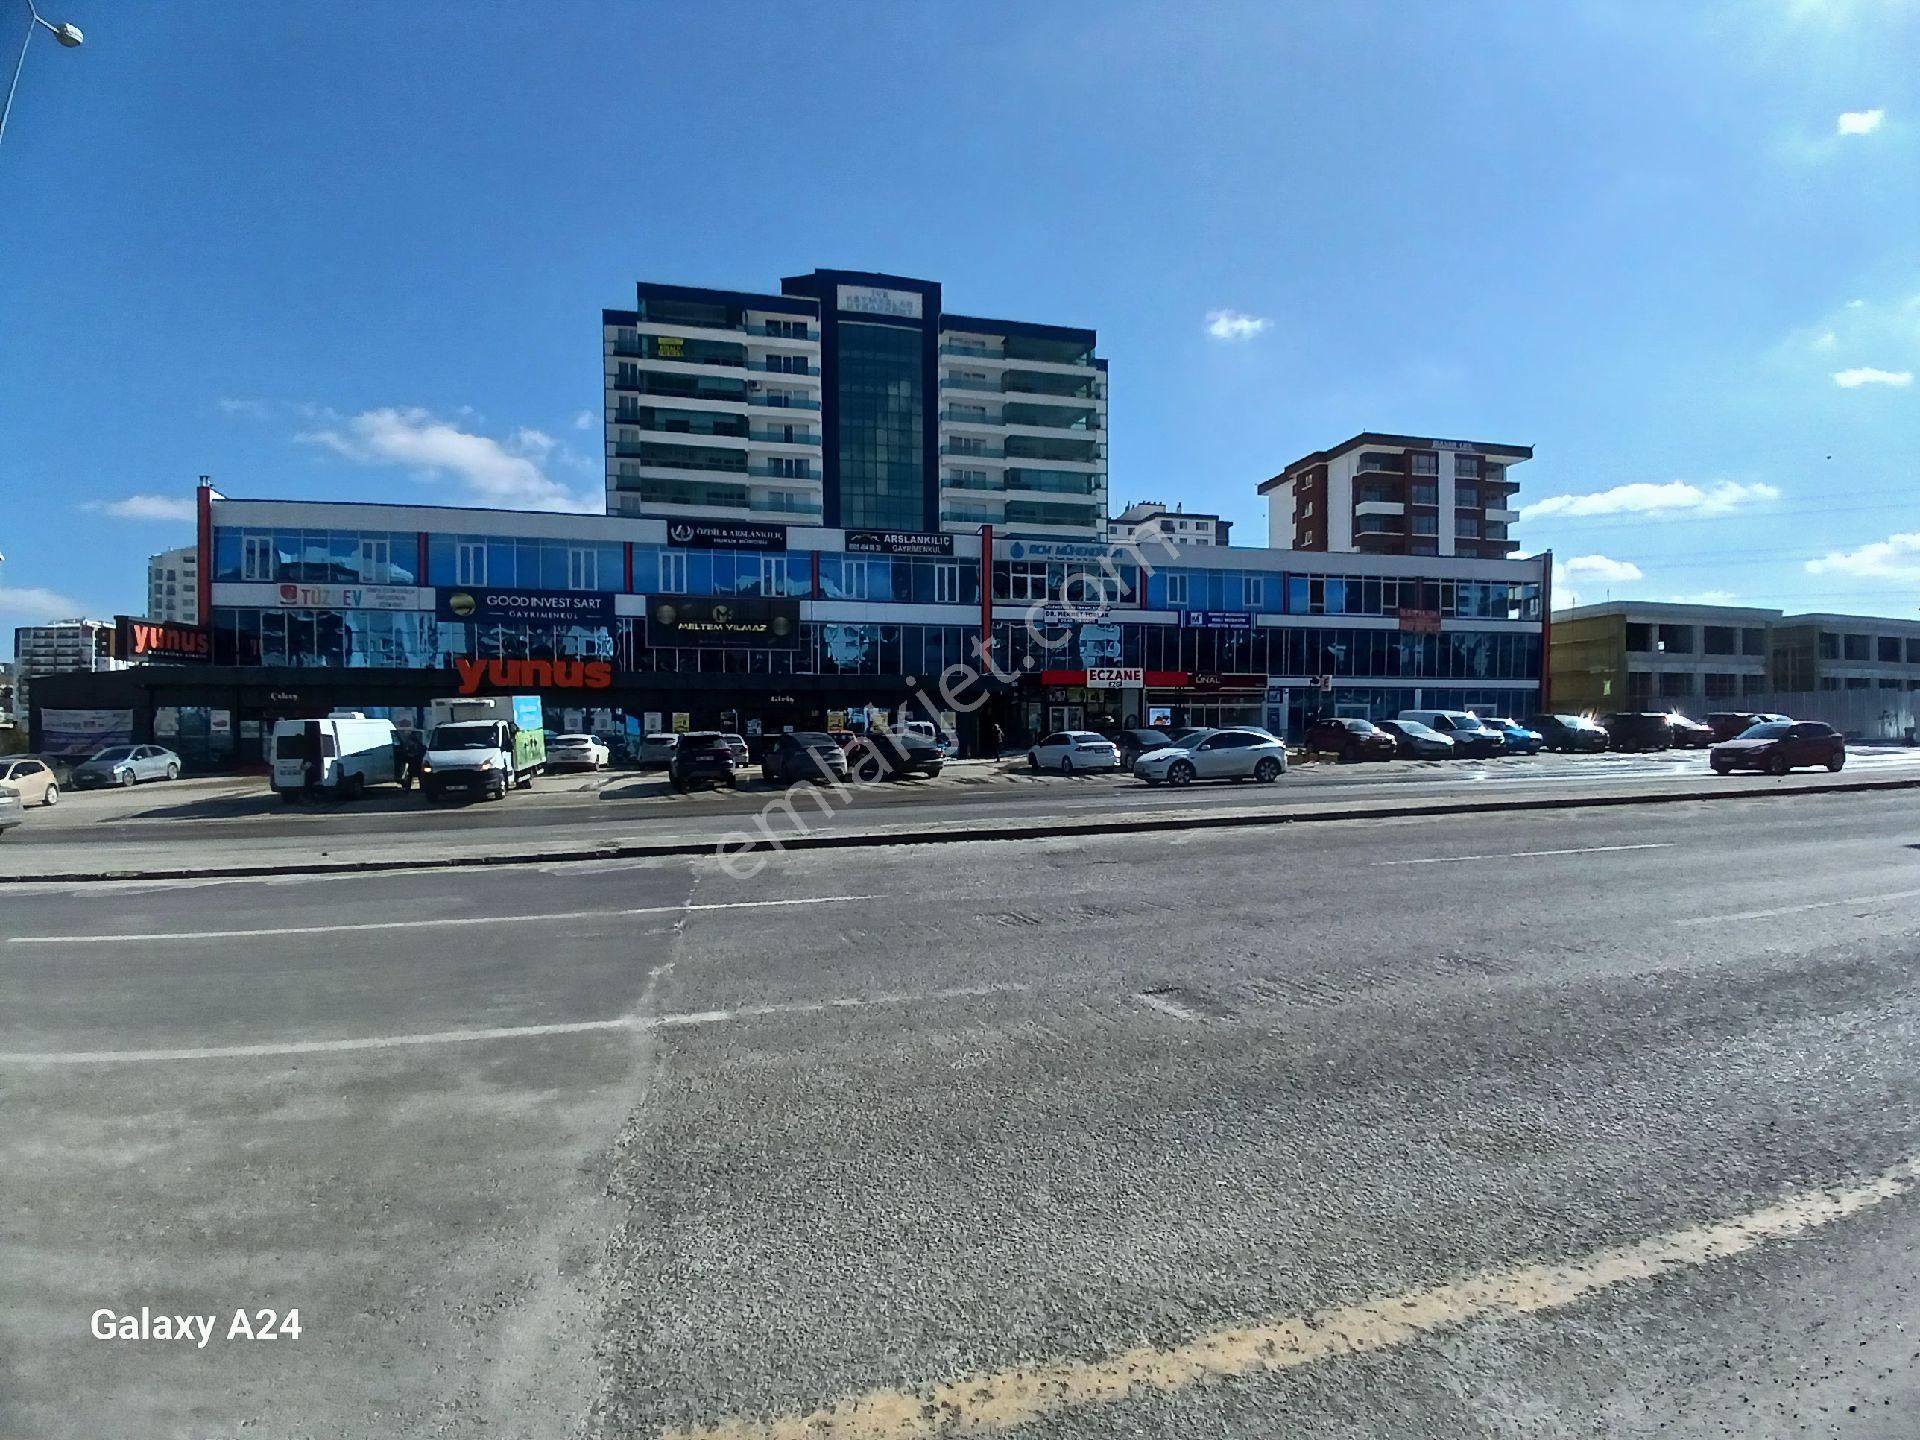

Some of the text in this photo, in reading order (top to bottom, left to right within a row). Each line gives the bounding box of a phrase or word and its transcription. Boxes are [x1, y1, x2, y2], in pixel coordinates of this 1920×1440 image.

[486, 595, 602, 609] GOOD INVEST SART
[678, 622, 768, 633] MELTEM YILMAZ
[133, 624, 209, 653] yunus
[455, 658, 613, 696] yunus
[1089, 669, 1141, 681] ECZANE
